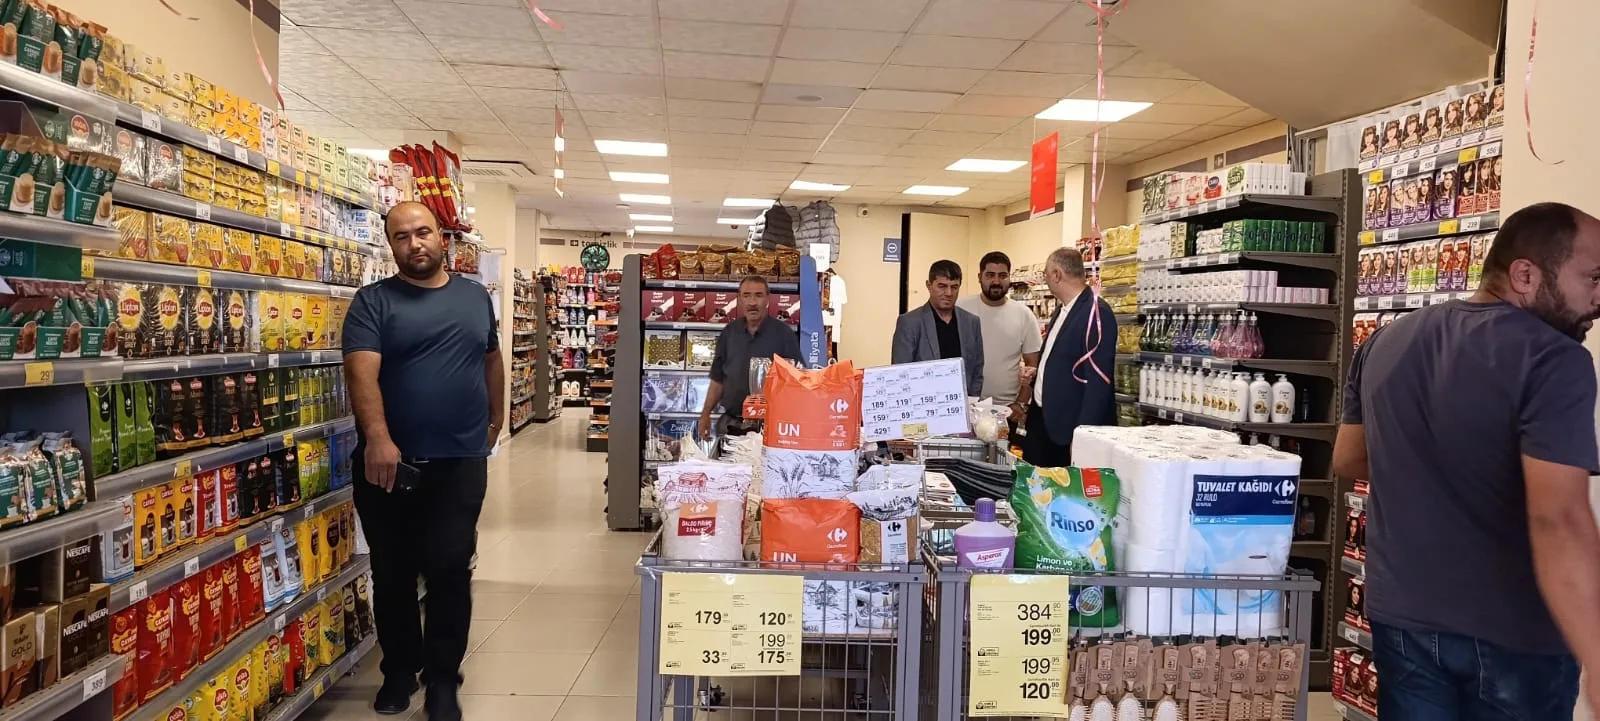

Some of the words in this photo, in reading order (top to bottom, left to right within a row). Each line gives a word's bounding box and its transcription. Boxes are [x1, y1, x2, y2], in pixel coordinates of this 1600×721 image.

[121, 301, 139, 314] Lipton
[161, 302, 177, 313] Lipton
[40, 370, 50, 381] 29
[896, 398, 909, 406] 119
[920, 396, 934, 404] 159
[945, 393, 959, 401] 189
[901, 411, 910, 419] 89
[946, 406, 960, 414] 159
[777, 422, 801, 437] UN
[1197, 481, 1237, 492] TUVALET
[1238, 479, 1273, 493] KAĞIDI
[1051, 512, 1095, 533] Rinso
[773, 551, 797, 562] UN
[976, 552, 1002, 562] Asperox
[1036, 554, 1061, 565] Limon
[695, 610, 722, 624] 179
[759, 612, 786, 625] 120
[1017, 603, 1052, 620] 384
[759, 633, 786, 647] 199
[1021, 628, 1052, 646] 199
[11, 641, 33, 658] GOLD
[702, 650, 720, 664] 33
[758, 650, 785, 664] 175
[1021, 658, 1050, 675] 199
[1123, 670, 1138, 679] eco
[1019, 682, 1050, 699] 120
